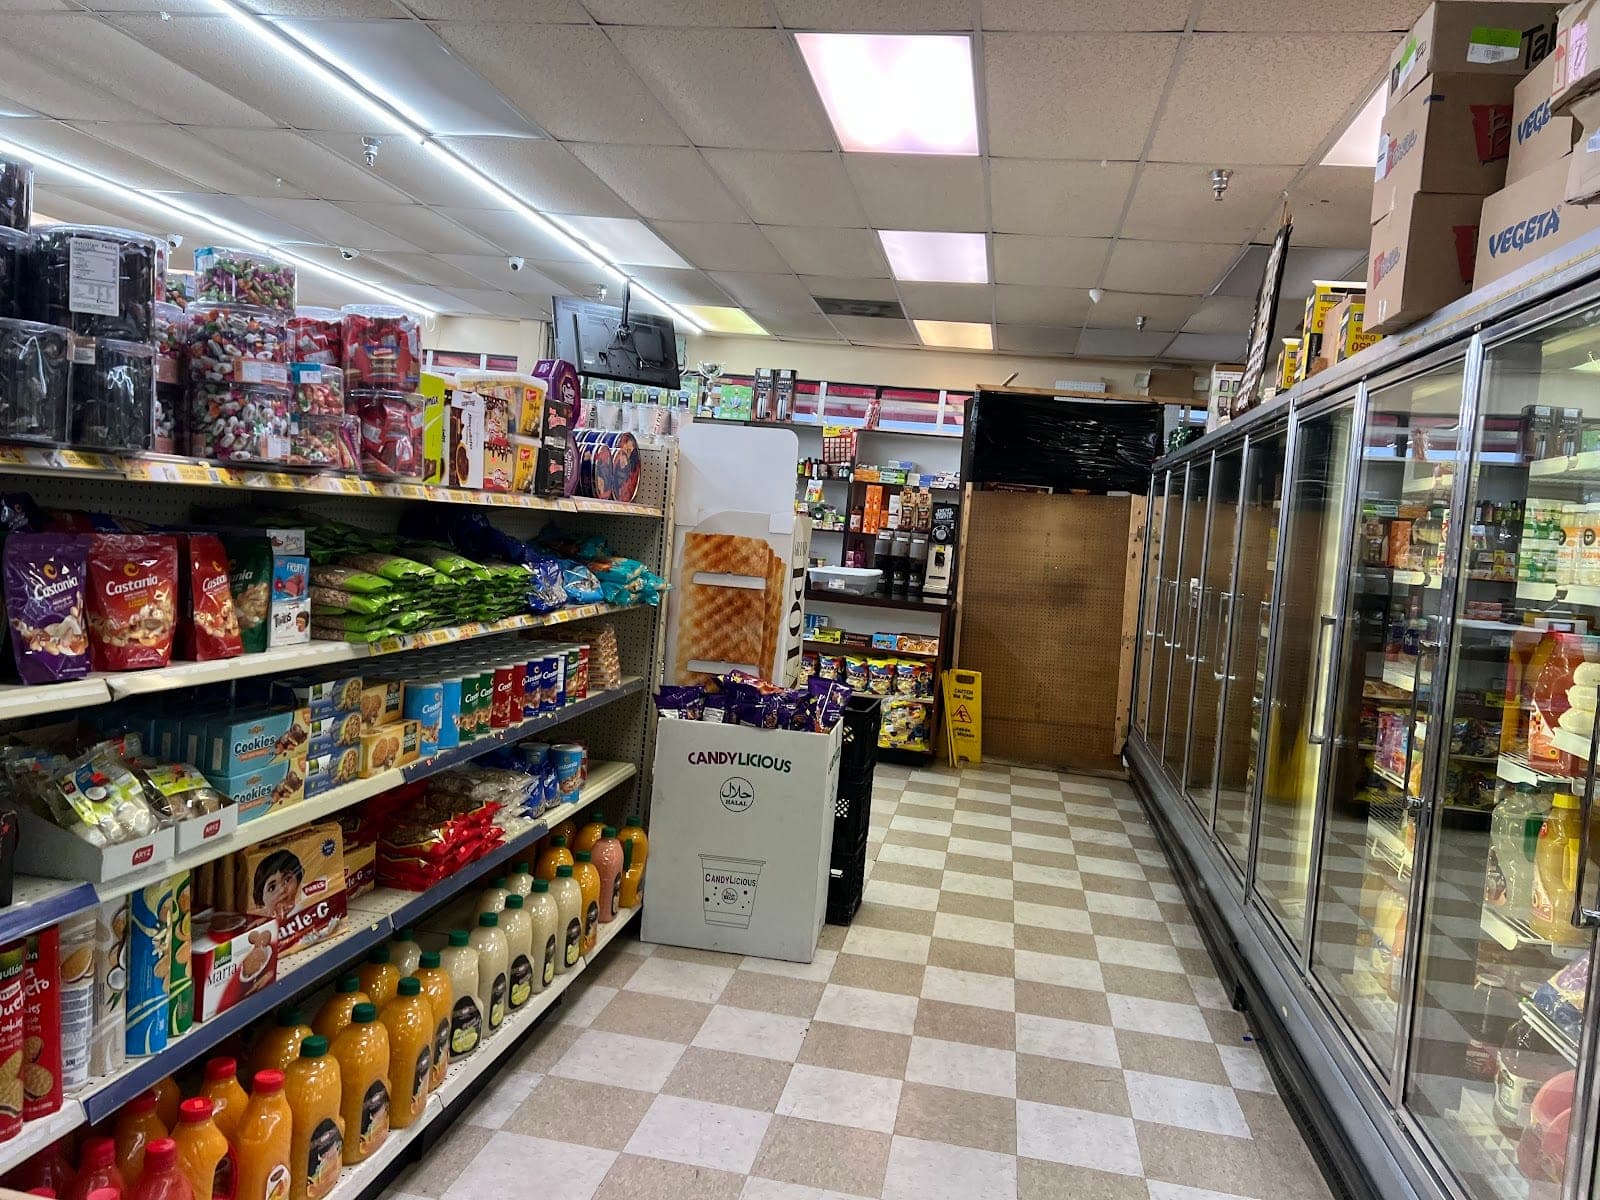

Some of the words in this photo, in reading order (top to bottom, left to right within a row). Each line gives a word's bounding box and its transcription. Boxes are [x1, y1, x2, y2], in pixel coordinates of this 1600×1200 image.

[1489, 208, 1560, 258] VEGETA
[34, 575, 78, 600] Castania
[106, 574, 158, 596] Castania
[234, 735, 276, 755] Cookies
[688, 750, 793, 773] CANDYLICIOUS
[721, 781, 753, 799] حلال
[705, 873, 758, 887] CANDYLICIOUS
[278, 901, 330, 940] arle-G
